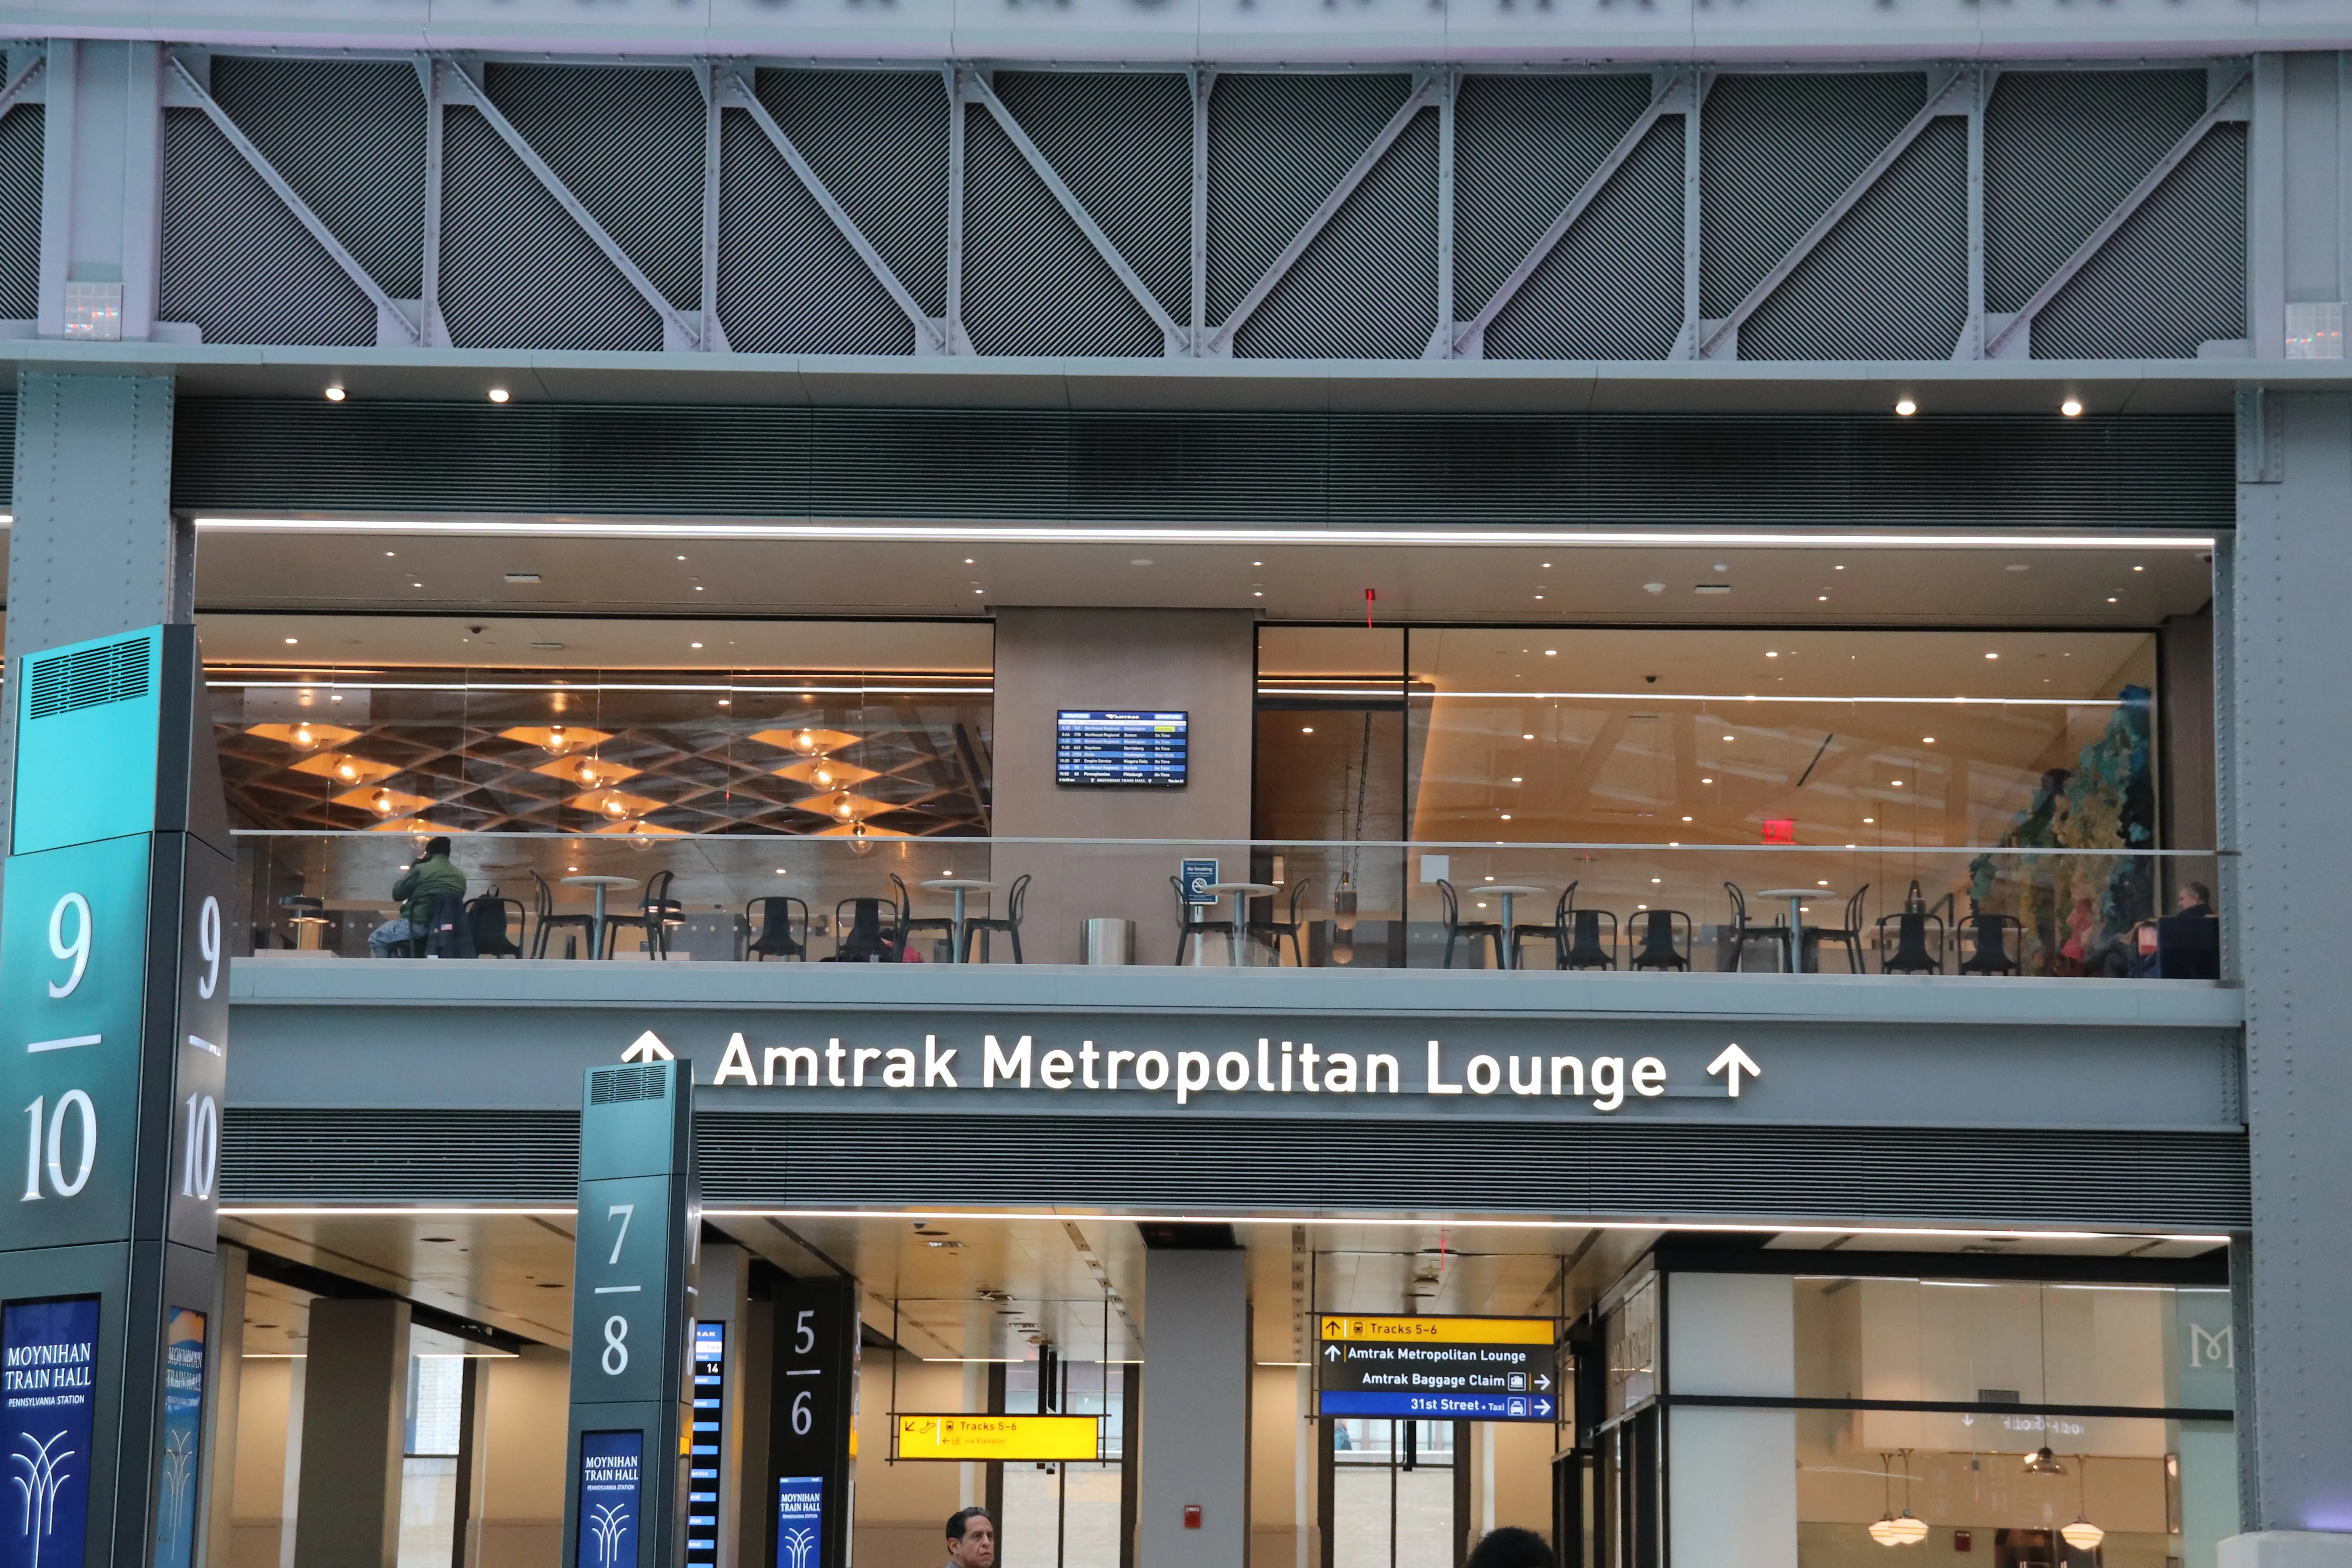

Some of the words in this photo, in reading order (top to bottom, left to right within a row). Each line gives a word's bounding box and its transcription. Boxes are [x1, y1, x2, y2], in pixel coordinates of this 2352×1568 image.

[49, 892, 92, 998] 9
[199, 895, 221, 999] 9
[713, 1032, 958, 1087] Amtrak
[983, 1035, 1399, 1104] Metropolitan
[1428, 1040, 1666, 1111] Lounge
[20, 1089, 97, 1201] 10
[181, 1092, 217, 1200] 10
[608, 1204, 634, 1264] 7
[795, 1310, 814, 1354] 5
[1371, 1323, 1411, 1334] Tracks
[1416, 1325, 1437, 1335] 5-6
[7, 1342, 92, 1367] MOYNIHAN
[602, 1315, 628, 1376] 8
[1348, 1347, 1394, 1359] Amtrak
[1398, 1348, 1477, 1362] Metropolitan
[1481, 1350, 1526, 1364] Lounge
[2189, 1323, 2234, 1368] M
[168, 1346, 203, 1369] MOYNIHAN
[707, 1363, 719, 1374] 14
[5, 1369, 50, 1390] TRAIN
[54, 1367, 92, 1388] HALL
[167, 1369, 186, 1388] TRAIN
[186, 1372, 201, 1391] HALL
[1362, 1373, 1408, 1385] Amtrak
[1412, 1374, 1466, 1388] Baggage
[1469, 1375, 1505, 1387] Claim
[9, 1397, 56, 1408] PENNSYLVANIA
[57, 1395, 85, 1405] STATION
[792, 1391, 812, 1435] 6
[1411, 1398, 1437, 1410] 31st
[1441, 1399, 1479, 1411] Street
[1488, 1403, 1505, 1411] Taxi
[960, 1421, 995, 1430] Tracks
[998, 1422, 1016, 1430] 5-6
[586, 1456, 638, 1468] MOYNIHAN
[584, 1470, 613, 1481] TRAIN
[615, 1469, 638, 1480] HALL
[780, 1503, 802, 1512] TRAIN
[803, 1503, 821, 1512] HALL
[781, 1493, 820, 1502] MOYNIHAN
